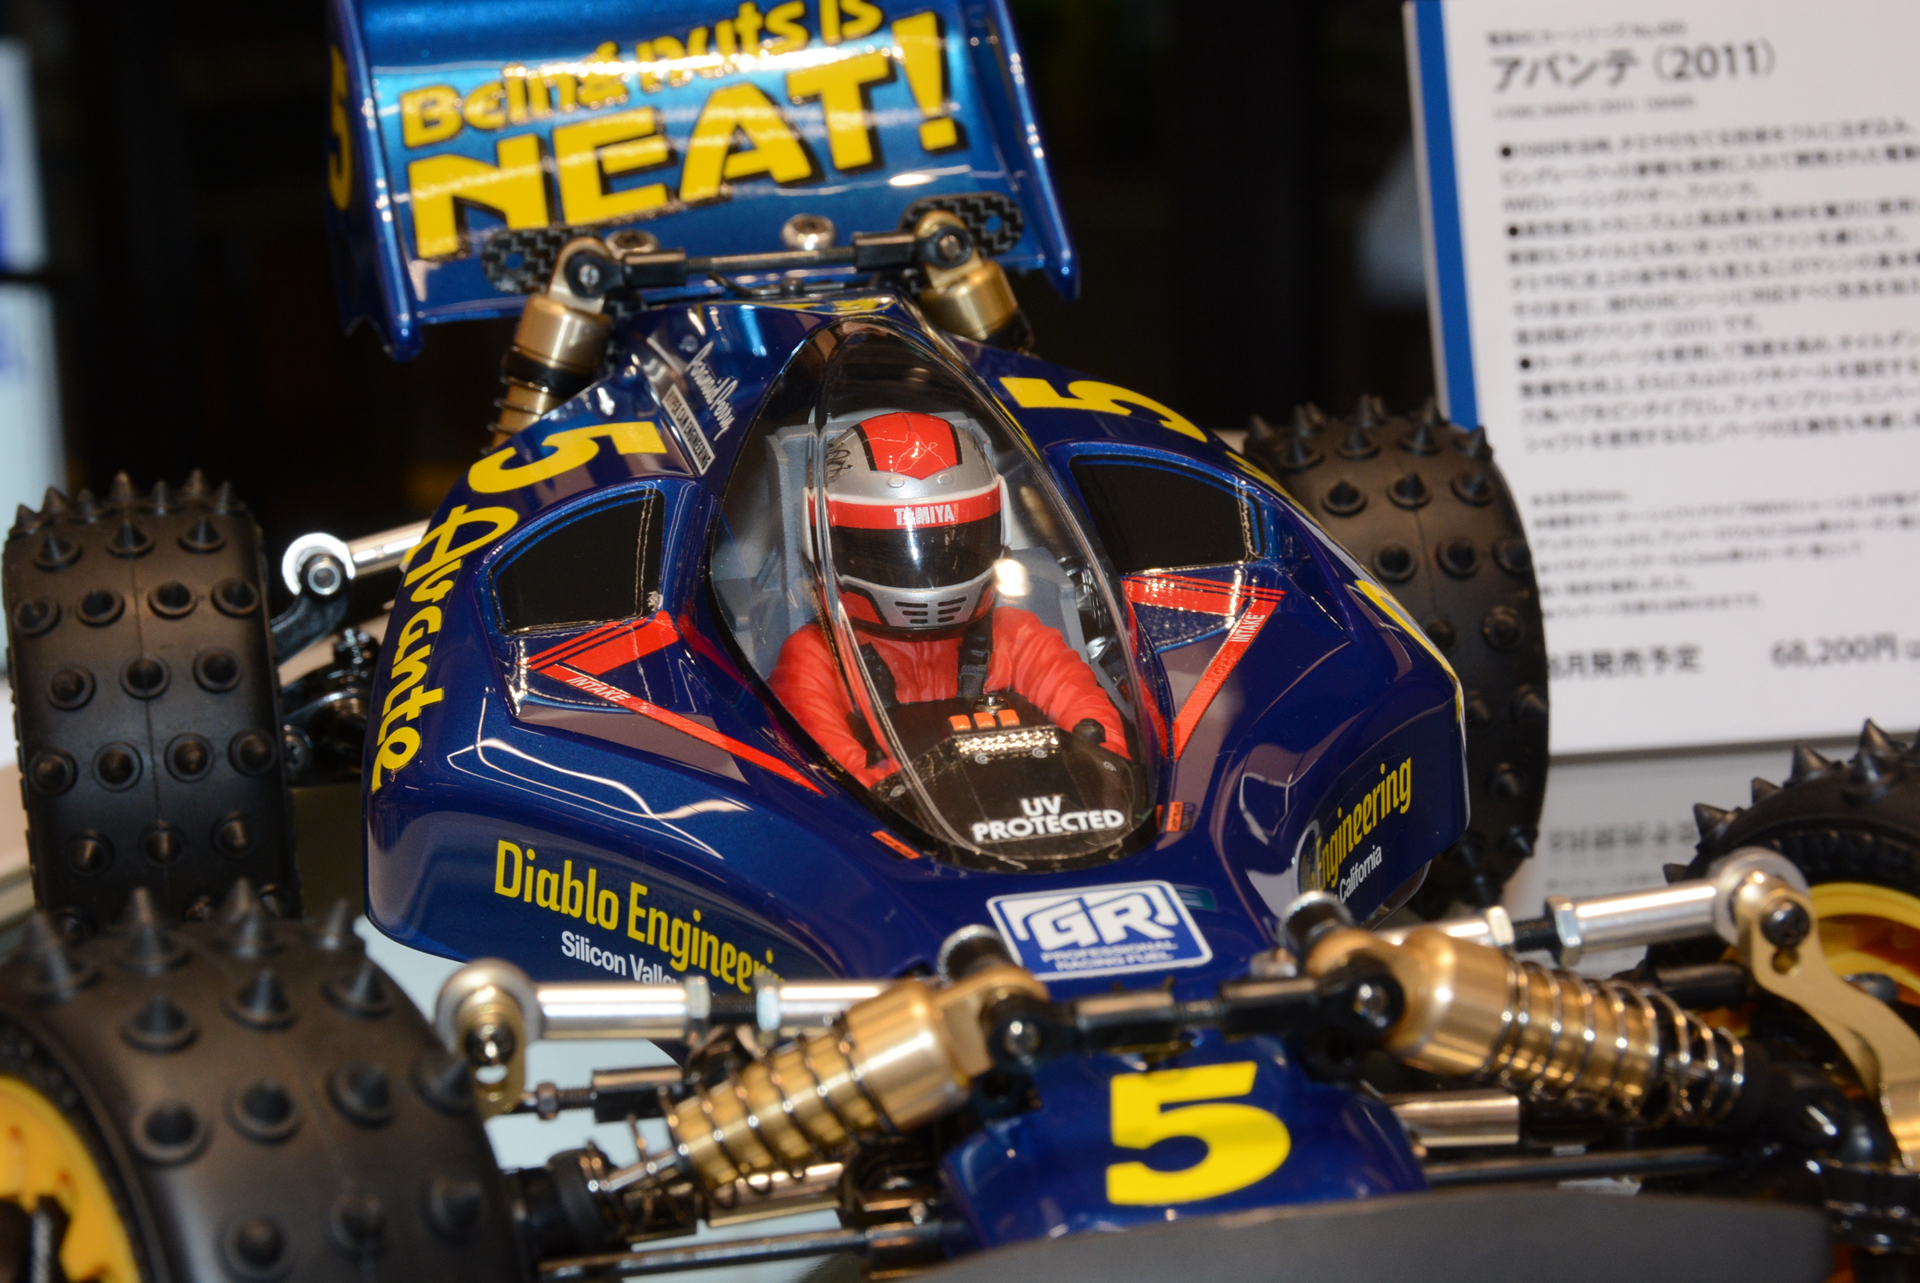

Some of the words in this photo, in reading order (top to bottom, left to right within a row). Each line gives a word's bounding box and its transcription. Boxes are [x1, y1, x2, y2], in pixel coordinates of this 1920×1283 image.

[400, 40, 629, 148] Being
[636, 1, 809, 92] nuts
[328, 45, 352, 212] 5
[407, 11, 962, 260] NEAT!
[999, 377, 1208, 443] 5
[468, 421, 668, 494] 5
[894, 504, 956, 526] TAMIYA
[1229, 613, 1267, 643] INTAKE
[565, 676, 631, 702] INTAKE
[973, 809, 1126, 843] PROTECTED
[1020, 796, 1063, 816] UV
[1316, 757, 1412, 891] Engineering
[494, 839, 619, 931] Diablo
[1339, 844, 1383, 904] California
[1020, 890, 1177, 951] GR
[561, 930, 627, 976] Silicon
[1041, 940, 1179, 963] PROFESSIONAL
[1055, 954, 1126, 971] RACING
[1127, 952, 1174, 966] FUEL
[1106, 1060, 1291, 1206] 5
